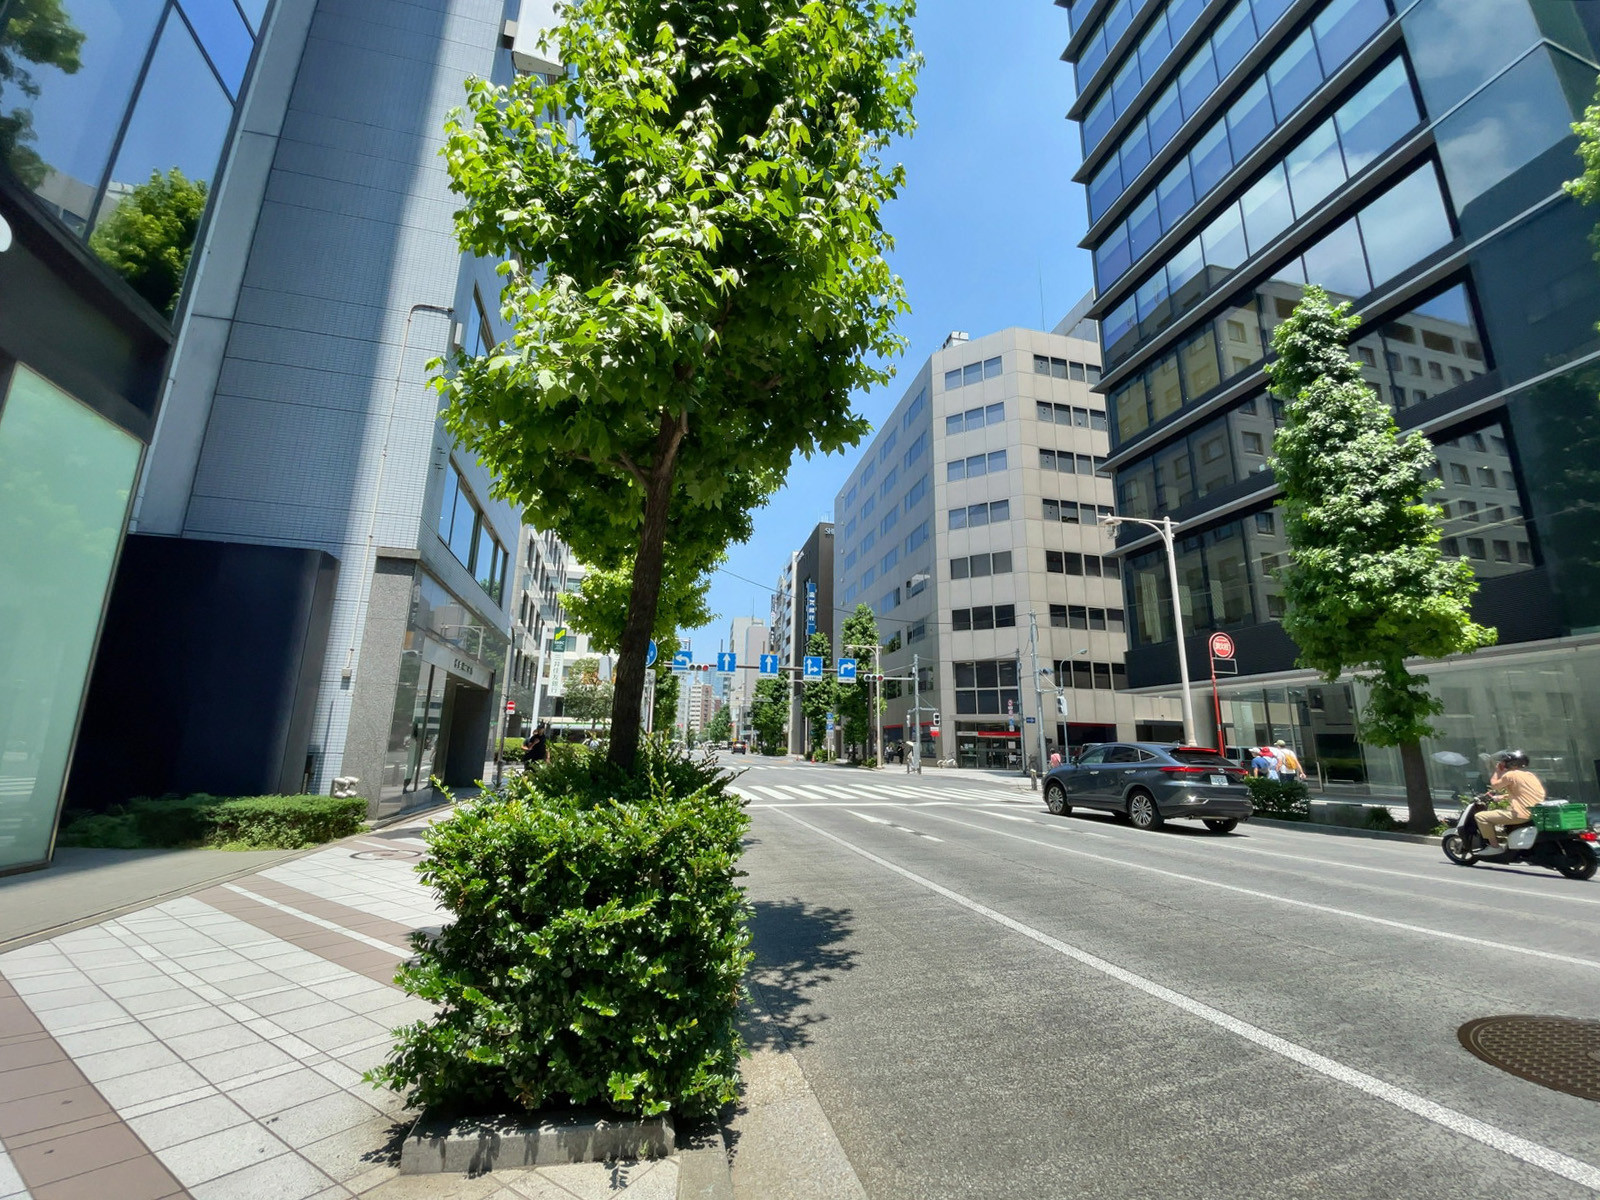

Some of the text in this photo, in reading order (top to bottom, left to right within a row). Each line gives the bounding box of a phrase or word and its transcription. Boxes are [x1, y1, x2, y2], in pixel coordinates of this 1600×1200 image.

[551, 653, 561, 694] 三井住友銀行
